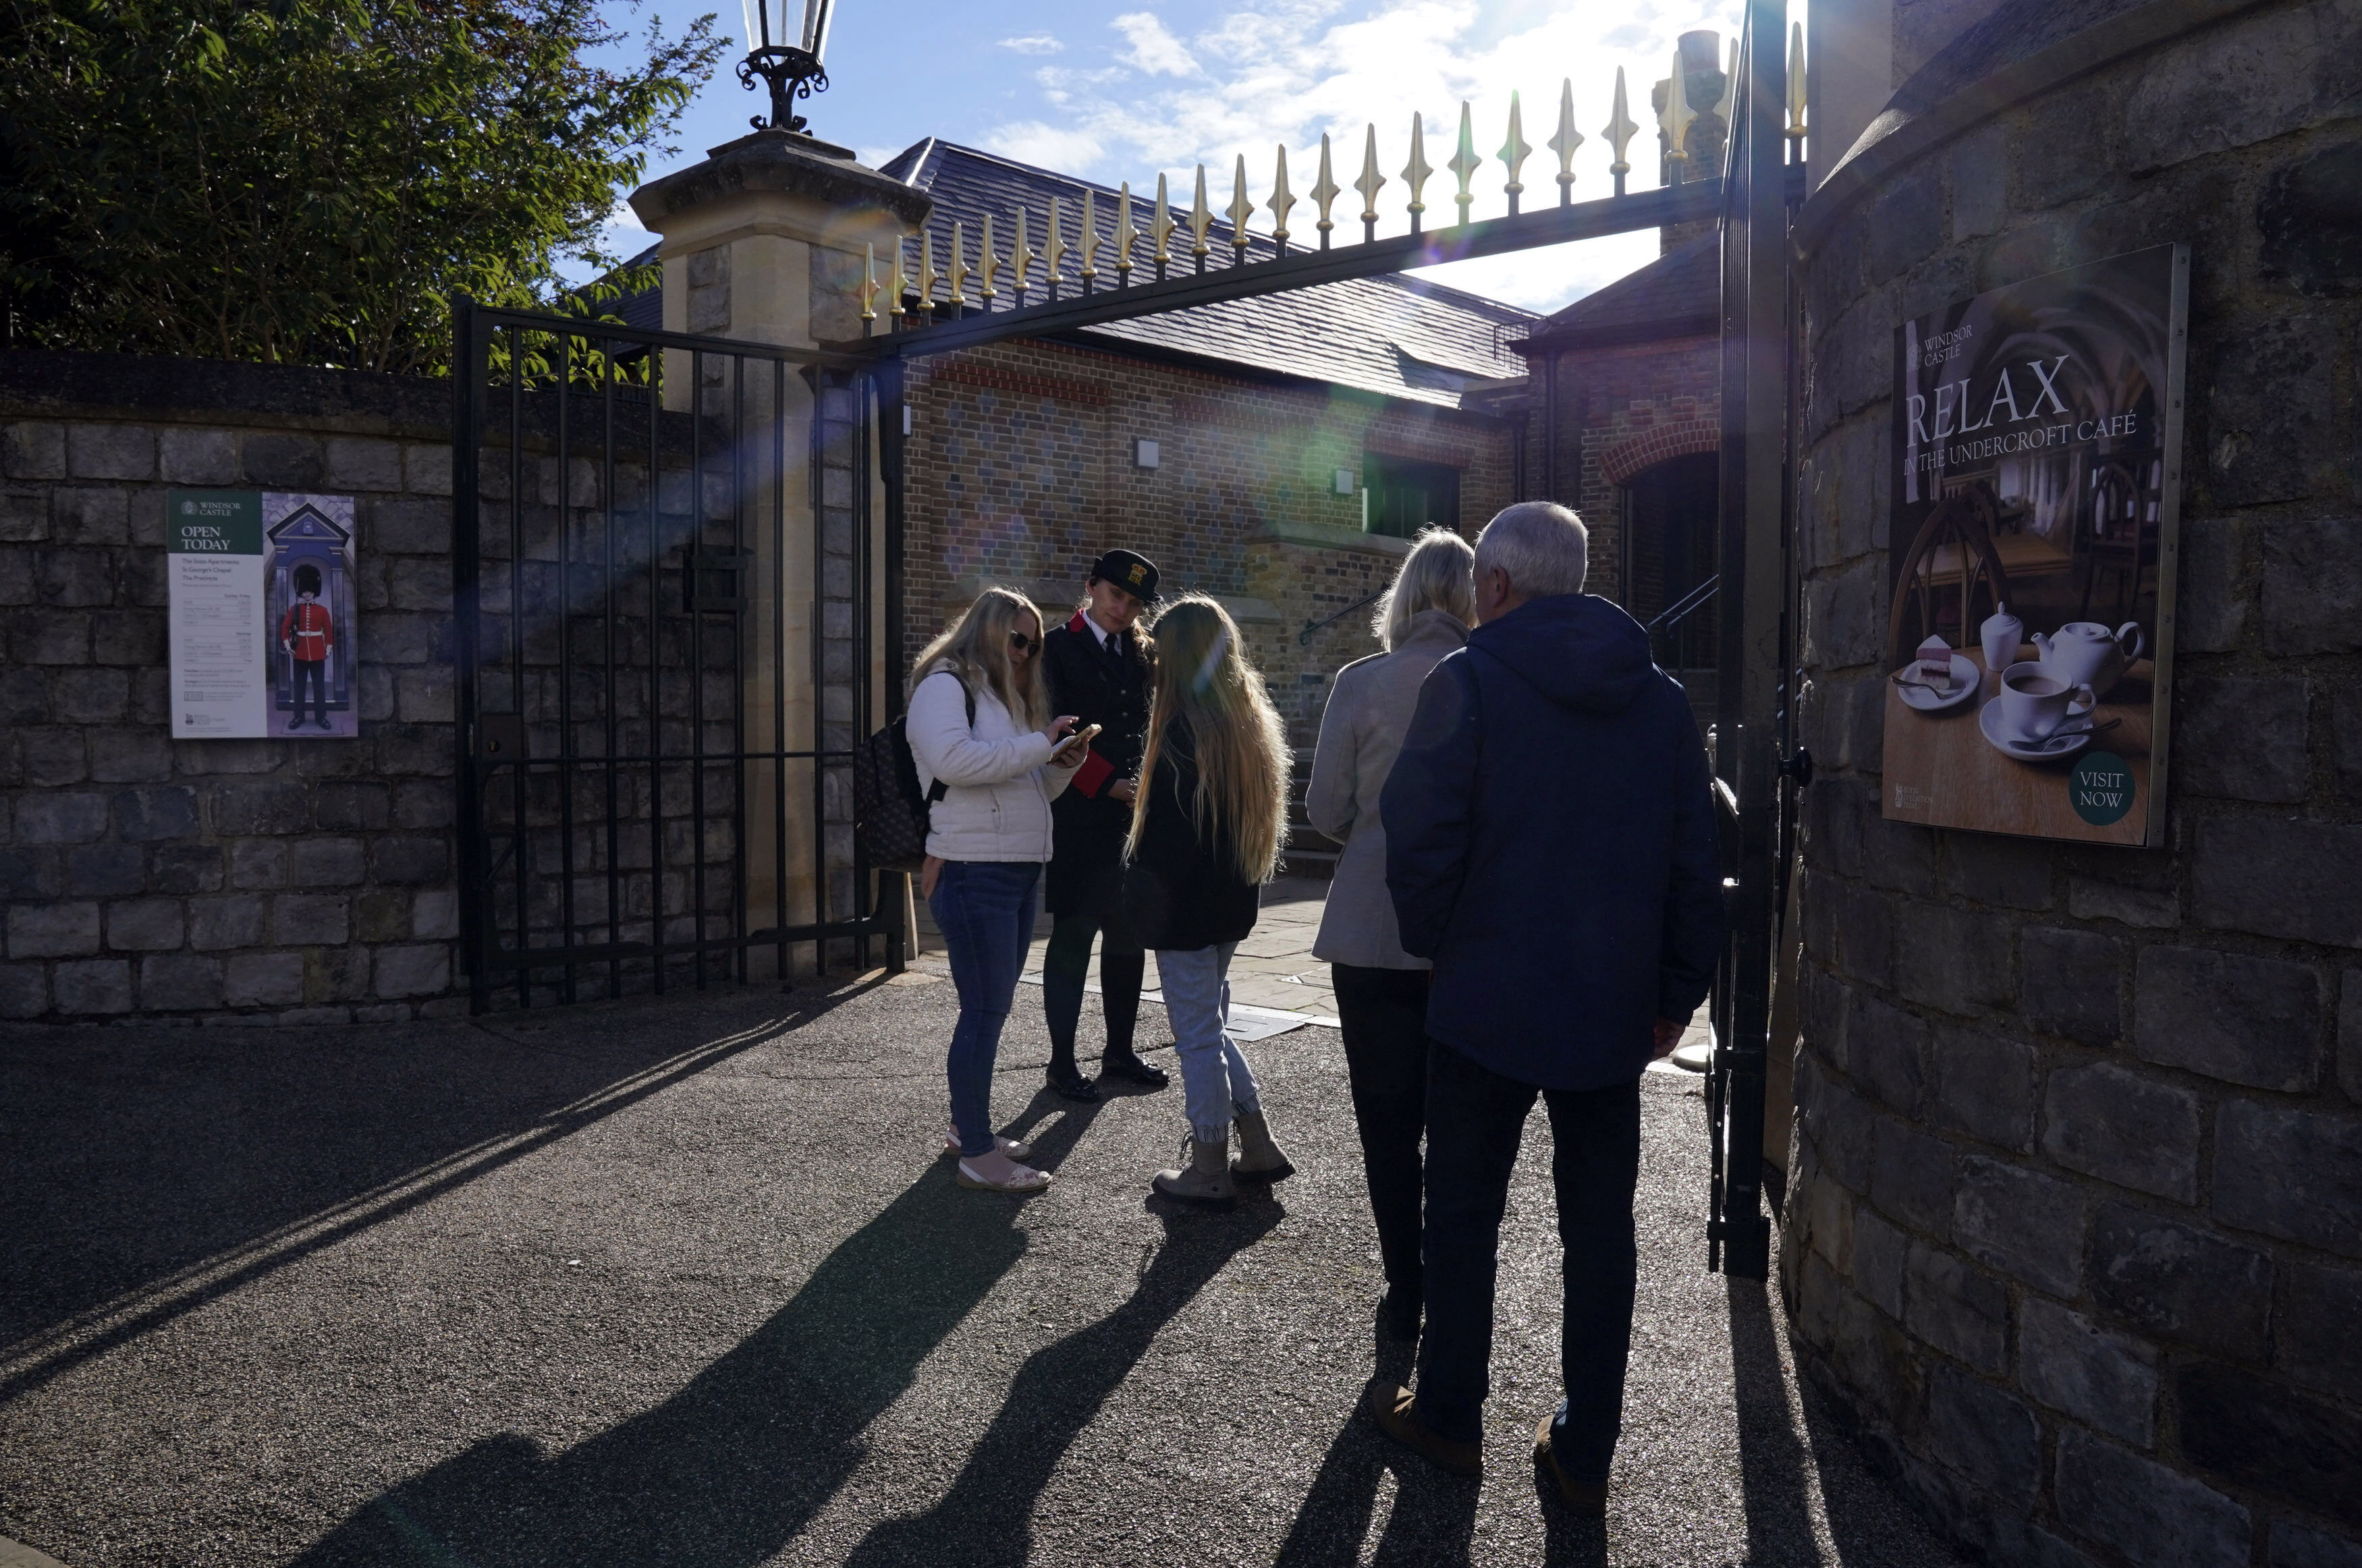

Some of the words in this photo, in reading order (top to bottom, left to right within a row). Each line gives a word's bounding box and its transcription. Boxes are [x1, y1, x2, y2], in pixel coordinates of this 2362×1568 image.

[1925, 325, 1972, 352] WINDSOR
[1924, 343, 1961, 367] CASTLE
[1906, 354, 2070, 449] RELAX
[1903, 456, 1917, 476] IN
[1919, 449, 1946, 472] THE
[1950, 424, 2072, 465] UNDERCROFT
[2077, 409, 2137, 441] CAFÉ
[200, 501, 242, 510] WINDSOR
[200, 509, 231, 517] CASTLE
[182, 526, 221, 538] OPEN
[182, 538, 231, 551] TODAY
[2080, 771, 2124, 788] VISIT
[2080, 791, 2123, 808] NOW
